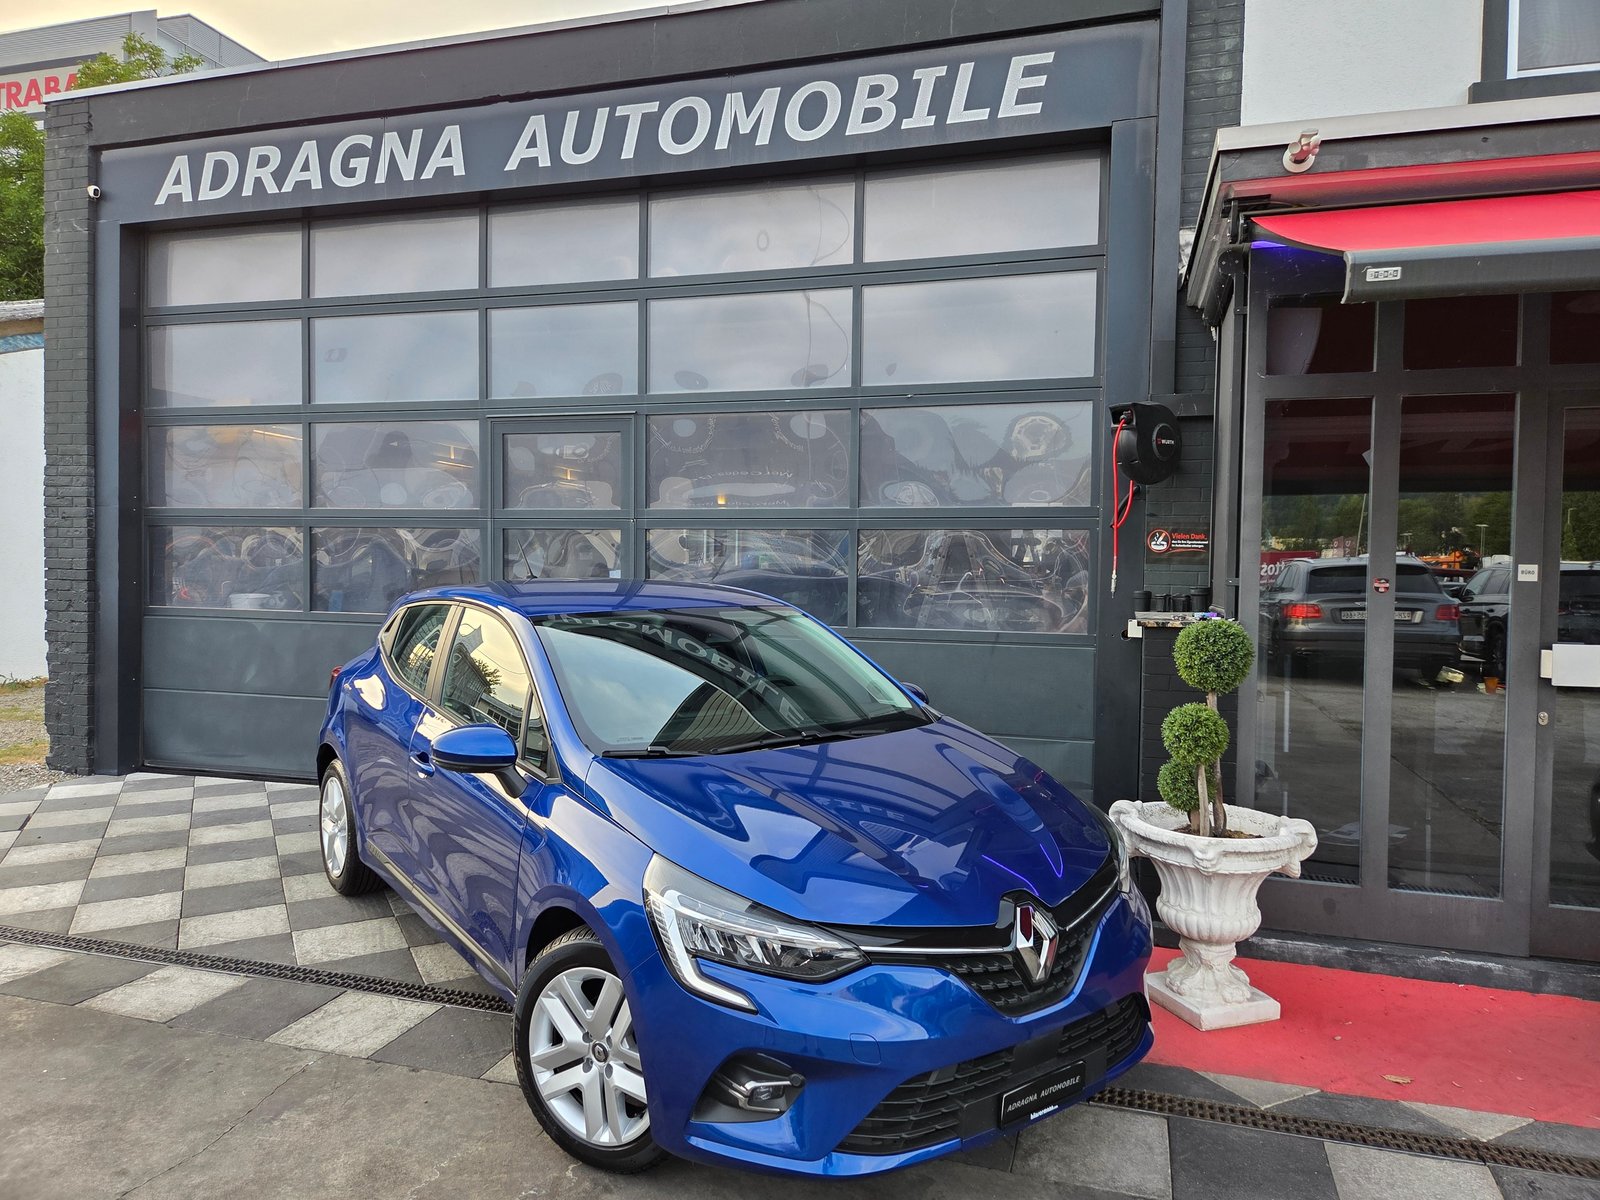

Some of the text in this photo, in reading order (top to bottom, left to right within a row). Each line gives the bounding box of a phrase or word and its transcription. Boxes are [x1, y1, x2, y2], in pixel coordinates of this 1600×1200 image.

[154, 51, 1056, 206] ADRAGNA AUTOMOBILE
[1007, 1076, 1080, 1112] ADRAGNA AUTOMOBILE
